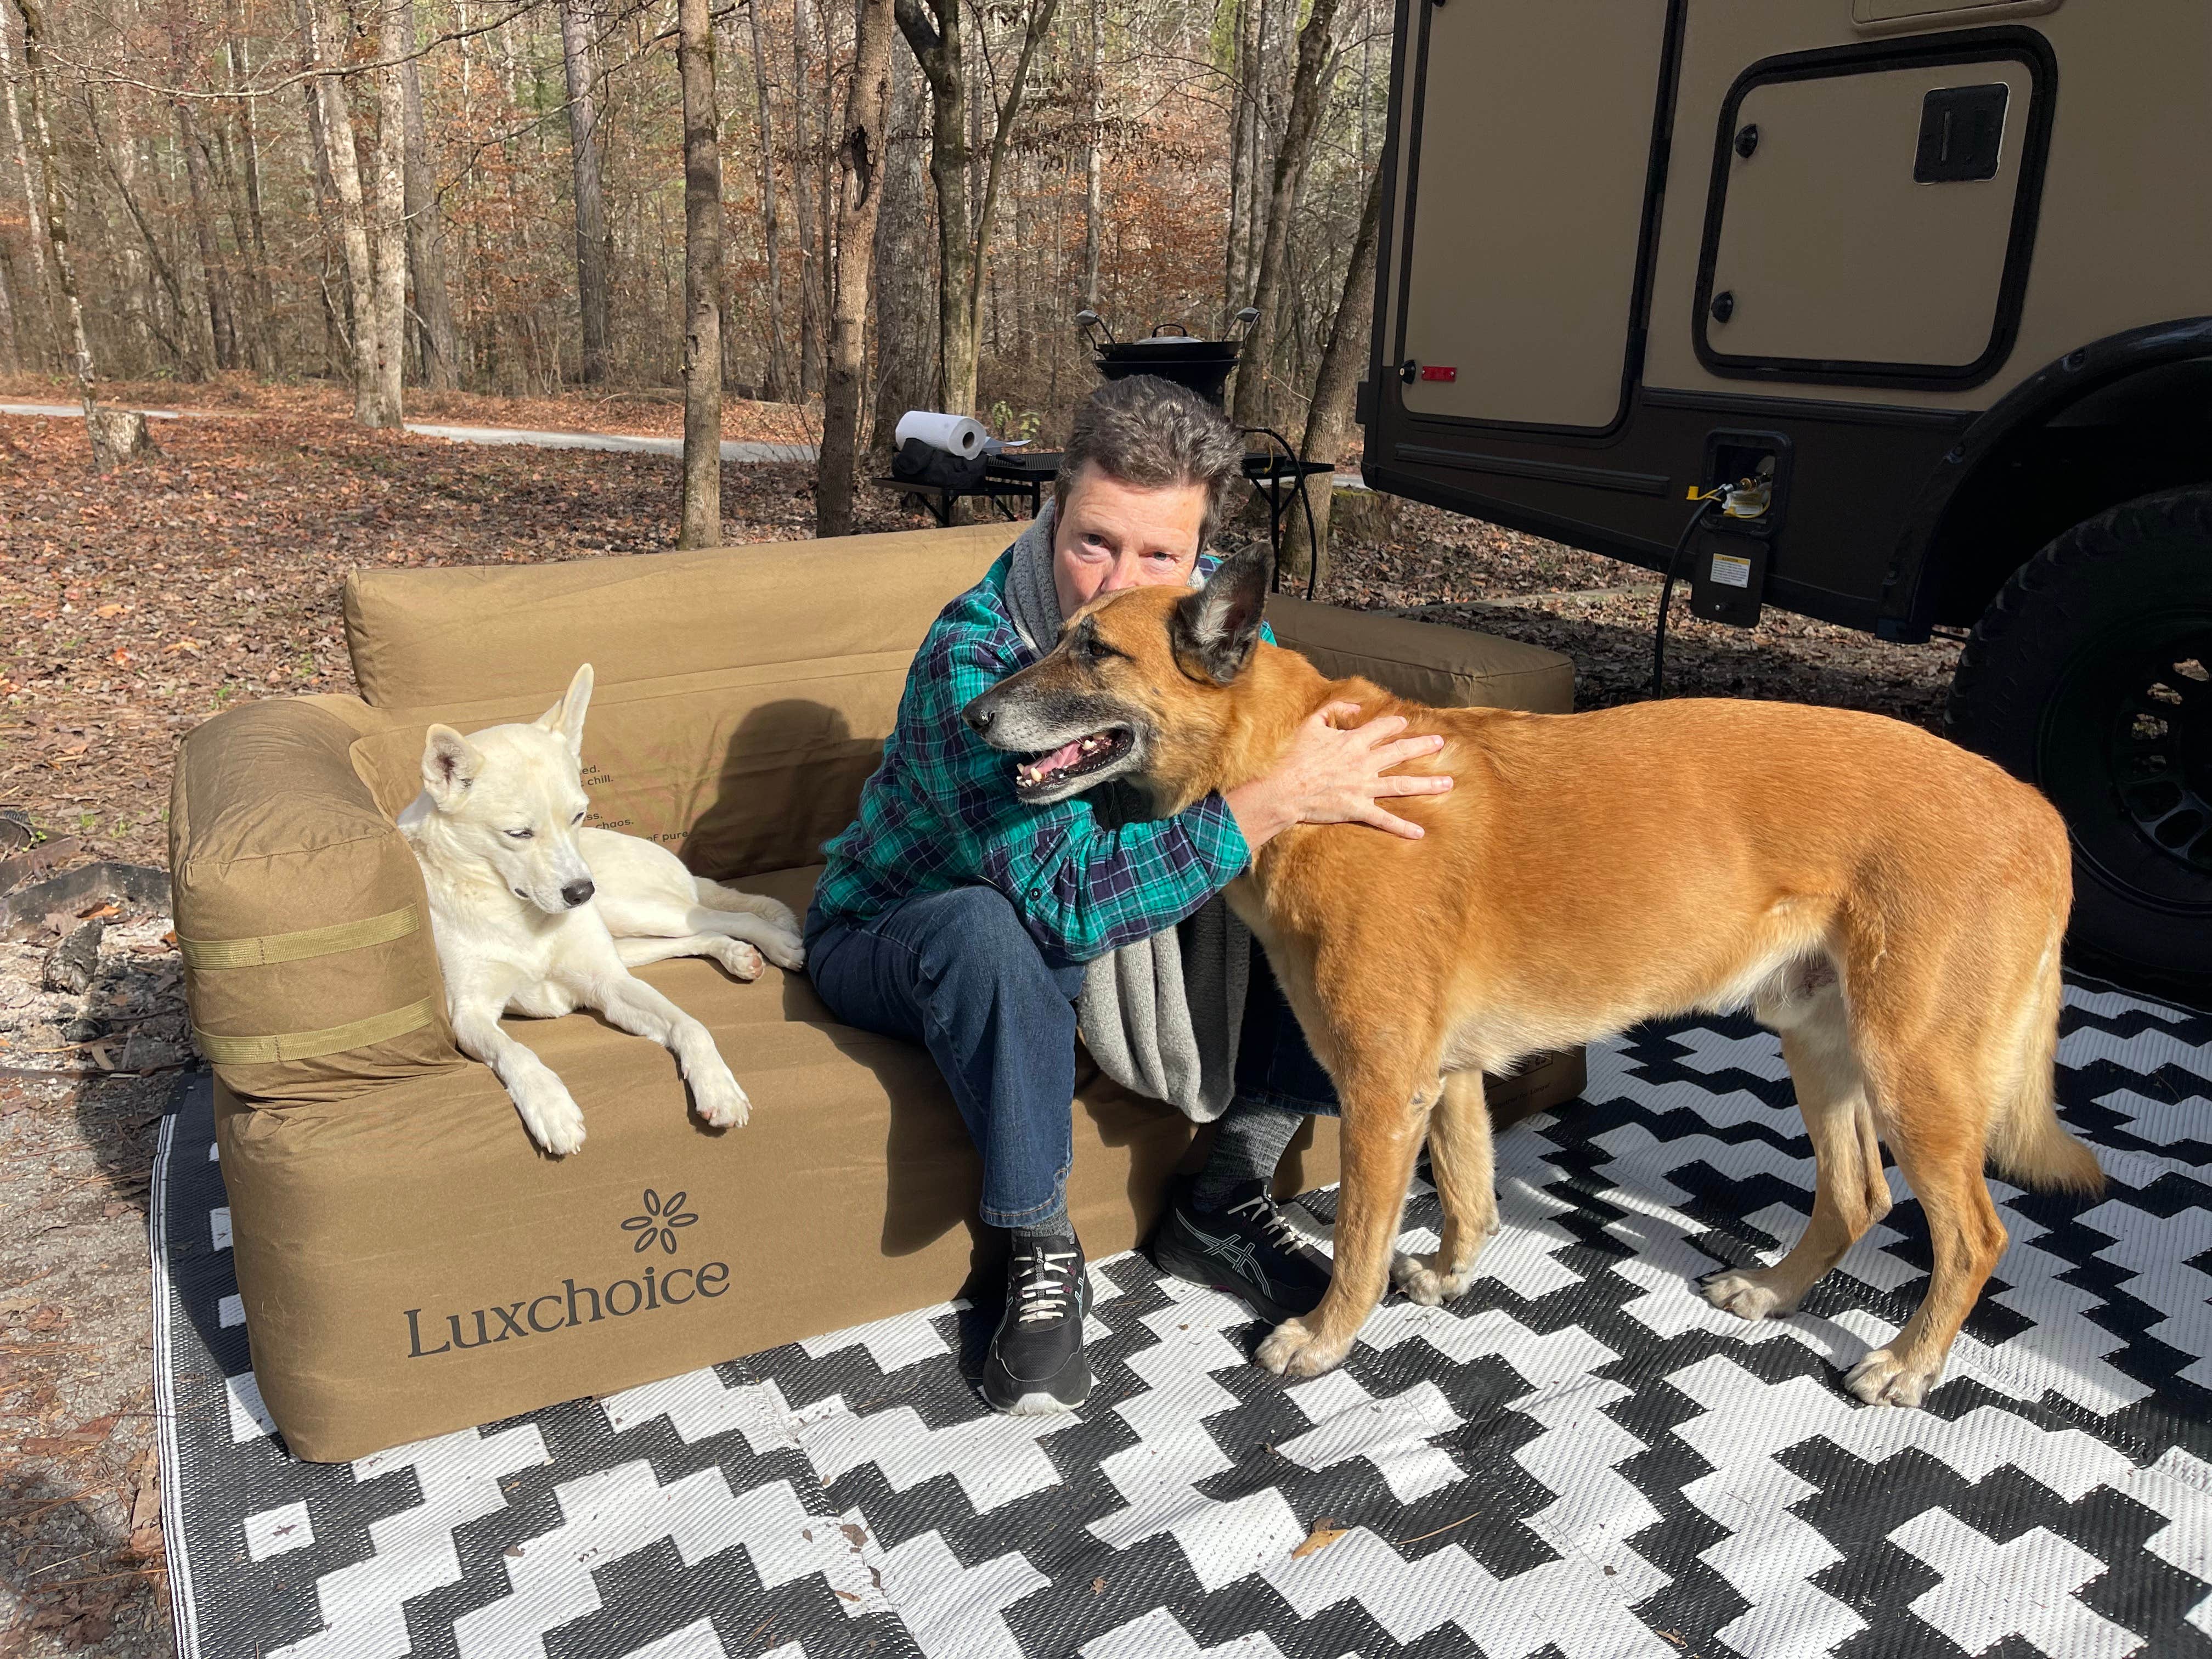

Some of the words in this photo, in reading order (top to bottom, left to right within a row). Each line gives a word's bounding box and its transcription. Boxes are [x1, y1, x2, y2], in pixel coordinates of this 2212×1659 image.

[588, 775, 614, 786] chill.
[596, 819, 634, 830] chaos.
[403, 1261, 730, 1358] Luxchoice
